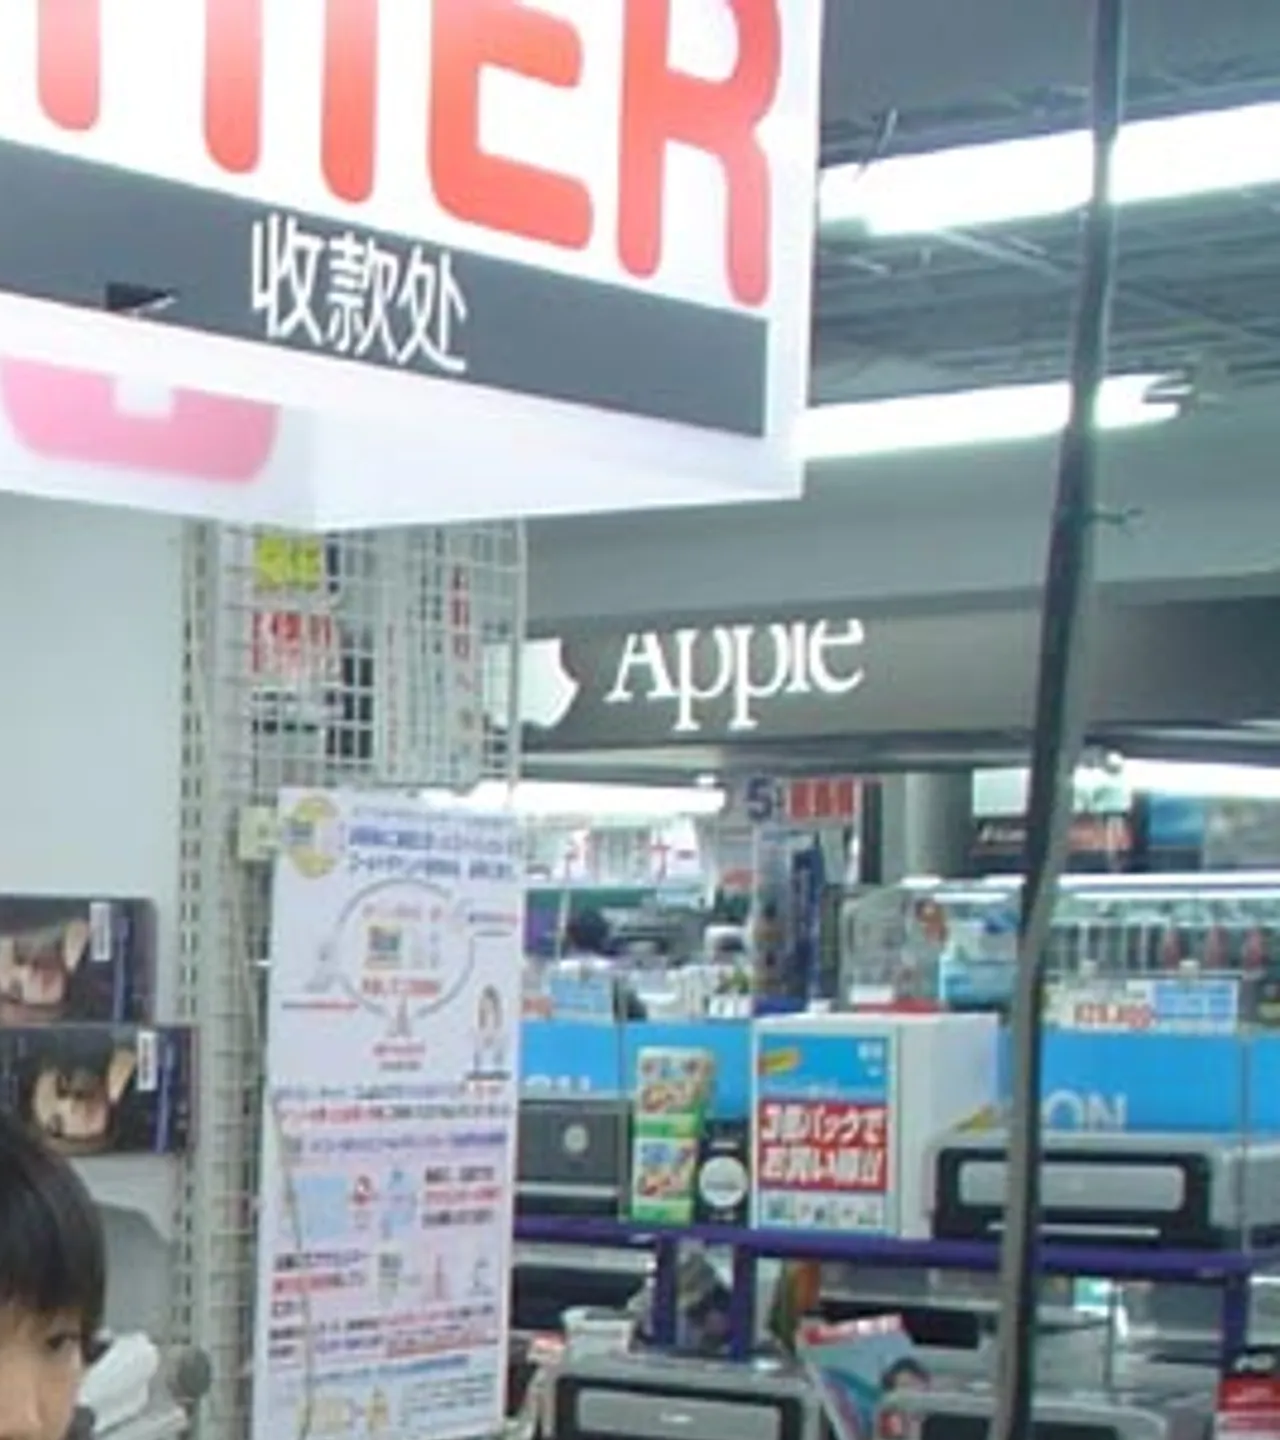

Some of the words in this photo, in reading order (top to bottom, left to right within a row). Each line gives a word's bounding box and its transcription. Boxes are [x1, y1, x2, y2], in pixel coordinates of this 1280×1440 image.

[249, 212, 468, 374] 收款处
[605, 618, 865, 731] Apple
